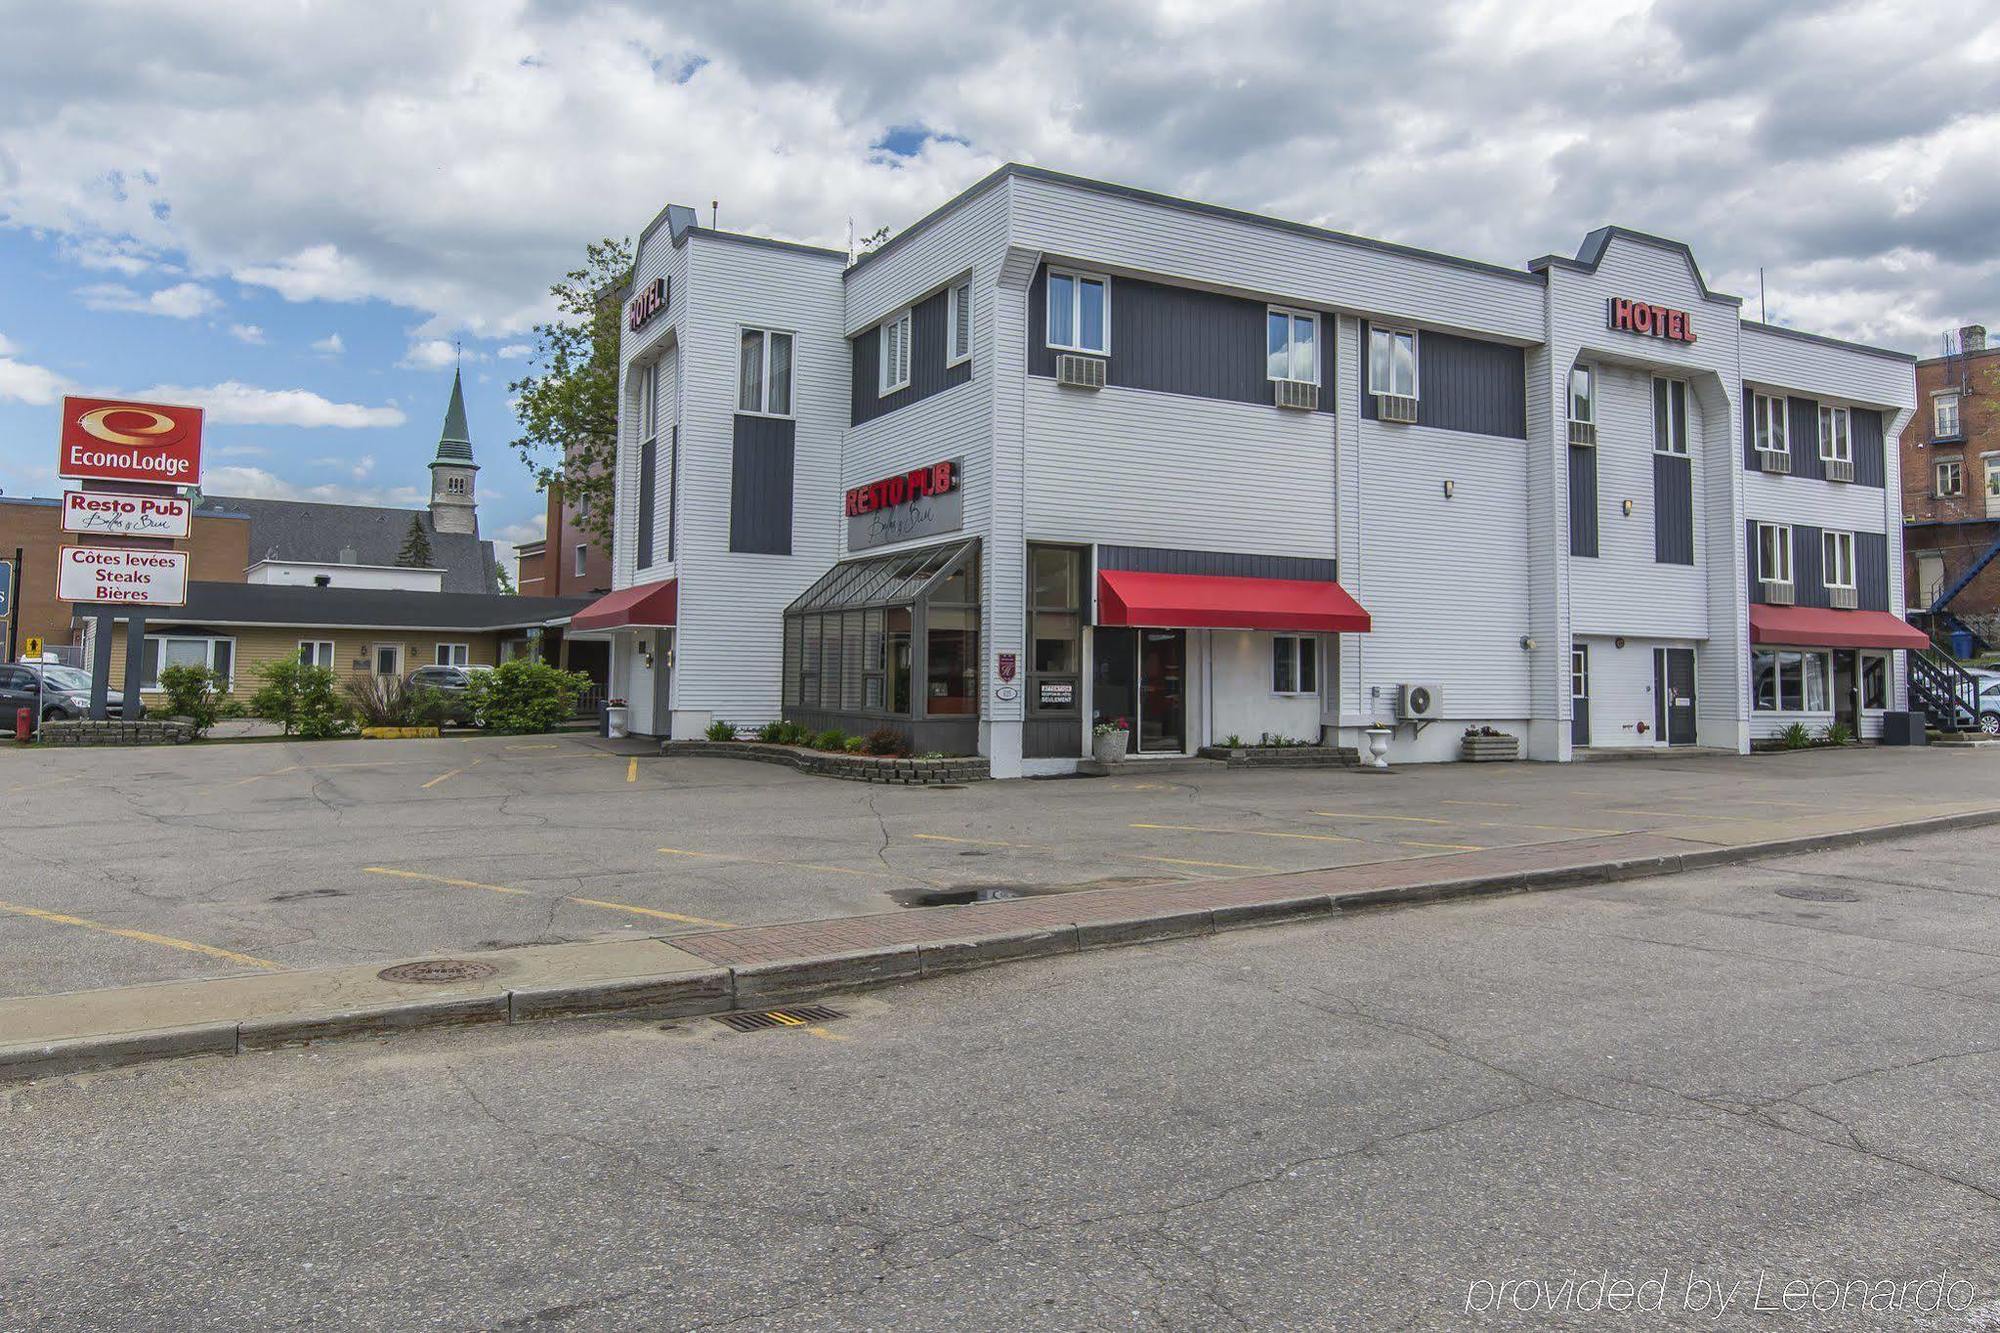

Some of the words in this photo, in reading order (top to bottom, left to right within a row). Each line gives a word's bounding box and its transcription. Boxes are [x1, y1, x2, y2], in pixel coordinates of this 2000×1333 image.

[631, 277, 662, 330] HOTEL
[1612, 297, 1697, 342] HOTEL
[70, 445, 189, 476] EconoLodge
[846, 475, 904, 517] RESTO
[908, 461, 952, 502] PUB
[71, 495, 136, 514] Resto
[141, 500, 183, 516] Pub
[72, 550, 121, 565] Côtes
[126, 553, 176, 568] levées
[95, 569, 151, 584] Steaks
[96, 586, 149, 600] Bières
